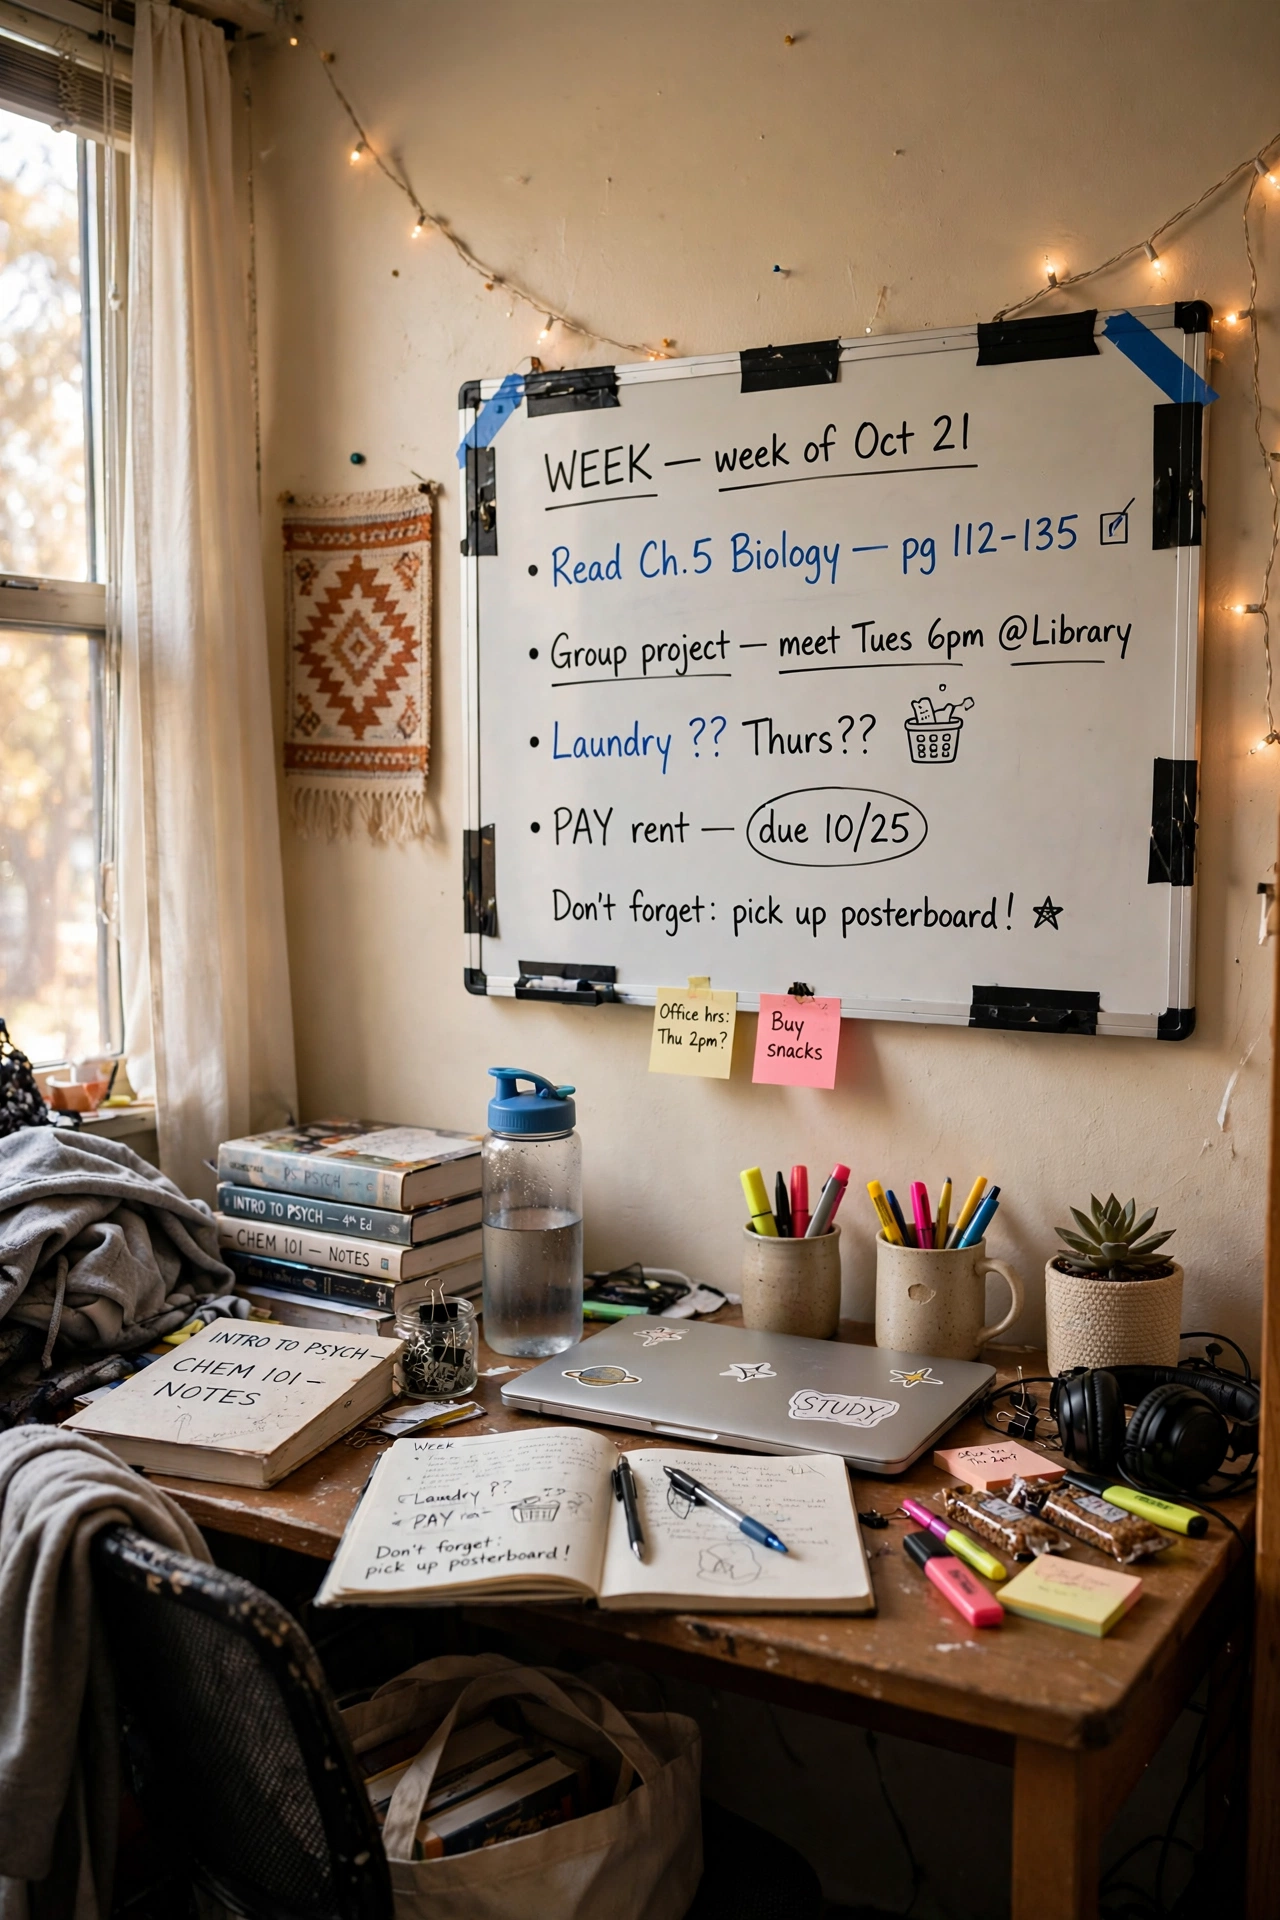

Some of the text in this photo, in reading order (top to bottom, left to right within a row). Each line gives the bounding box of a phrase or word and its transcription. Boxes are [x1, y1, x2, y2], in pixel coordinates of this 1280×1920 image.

[545, 443, 653, 493] WEEK
[715, 432, 791, 474] week
[803, 422, 837, 464] of
[855, 420, 915, 460] Oct
[932, 412, 969, 455] 21
[552, 543, 623, 588] Read
[639, 533, 713, 579] Ch.5
[731, 529, 840, 585] Biology
[902, 537, 936, 576] pg
[551, 632, 628, 678] Group
[641, 629, 731, 678] project
[779, 626, 841, 659] meet
[852, 619, 914, 655] Tues
[927, 618, 985, 661] 6pm
[998, 613, 1133, 660] @Library
[552, 714, 877, 775] Laundry ?? Thurs??
[554, 807, 614, 847] PAY
[631, 810, 690, 845] rent
[759, 807, 809, 845] due
[824, 802, 910, 853] 10/25
[552, 888, 1015, 939] Don't forget: pick up posterboard!
[659, 1002, 730, 1024] Office hrs:
[771, 1010, 805, 1041] Buy
[657, 1027, 728, 1053] Thu 2pm?
[767, 1042, 823, 1060] snacks
[304, 1171, 342, 1189] PSYCH
[233, 1195, 266, 1215] INTRO
[270, 1201, 285, 1217] TO
[287, 1203, 324, 1225] PSYCH
[359, 1217, 373, 1232] Ed
[236, 1228, 277, 1251] CHEM
[284, 1238, 303, 1257] 101
[328, 1246, 371, 1267] NOTES
[209, 1331, 271, 1348] INTRO
[275, 1338, 300, 1351] TO
[303, 1342, 369, 1360] PSYCH
[173, 1357, 256, 1379] CHEM
[261, 1367, 302, 1386] 101
[153, 1381, 262, 1406] NOTES
[798, 1396, 885, 1420] STUDY
[414, 1441, 455, 1451] Week
[413, 1509, 455, 1530] PAY
[365, 1544, 571, 1579] pick up posterboard!
[376, 1535, 502, 1560] Don't forget:
